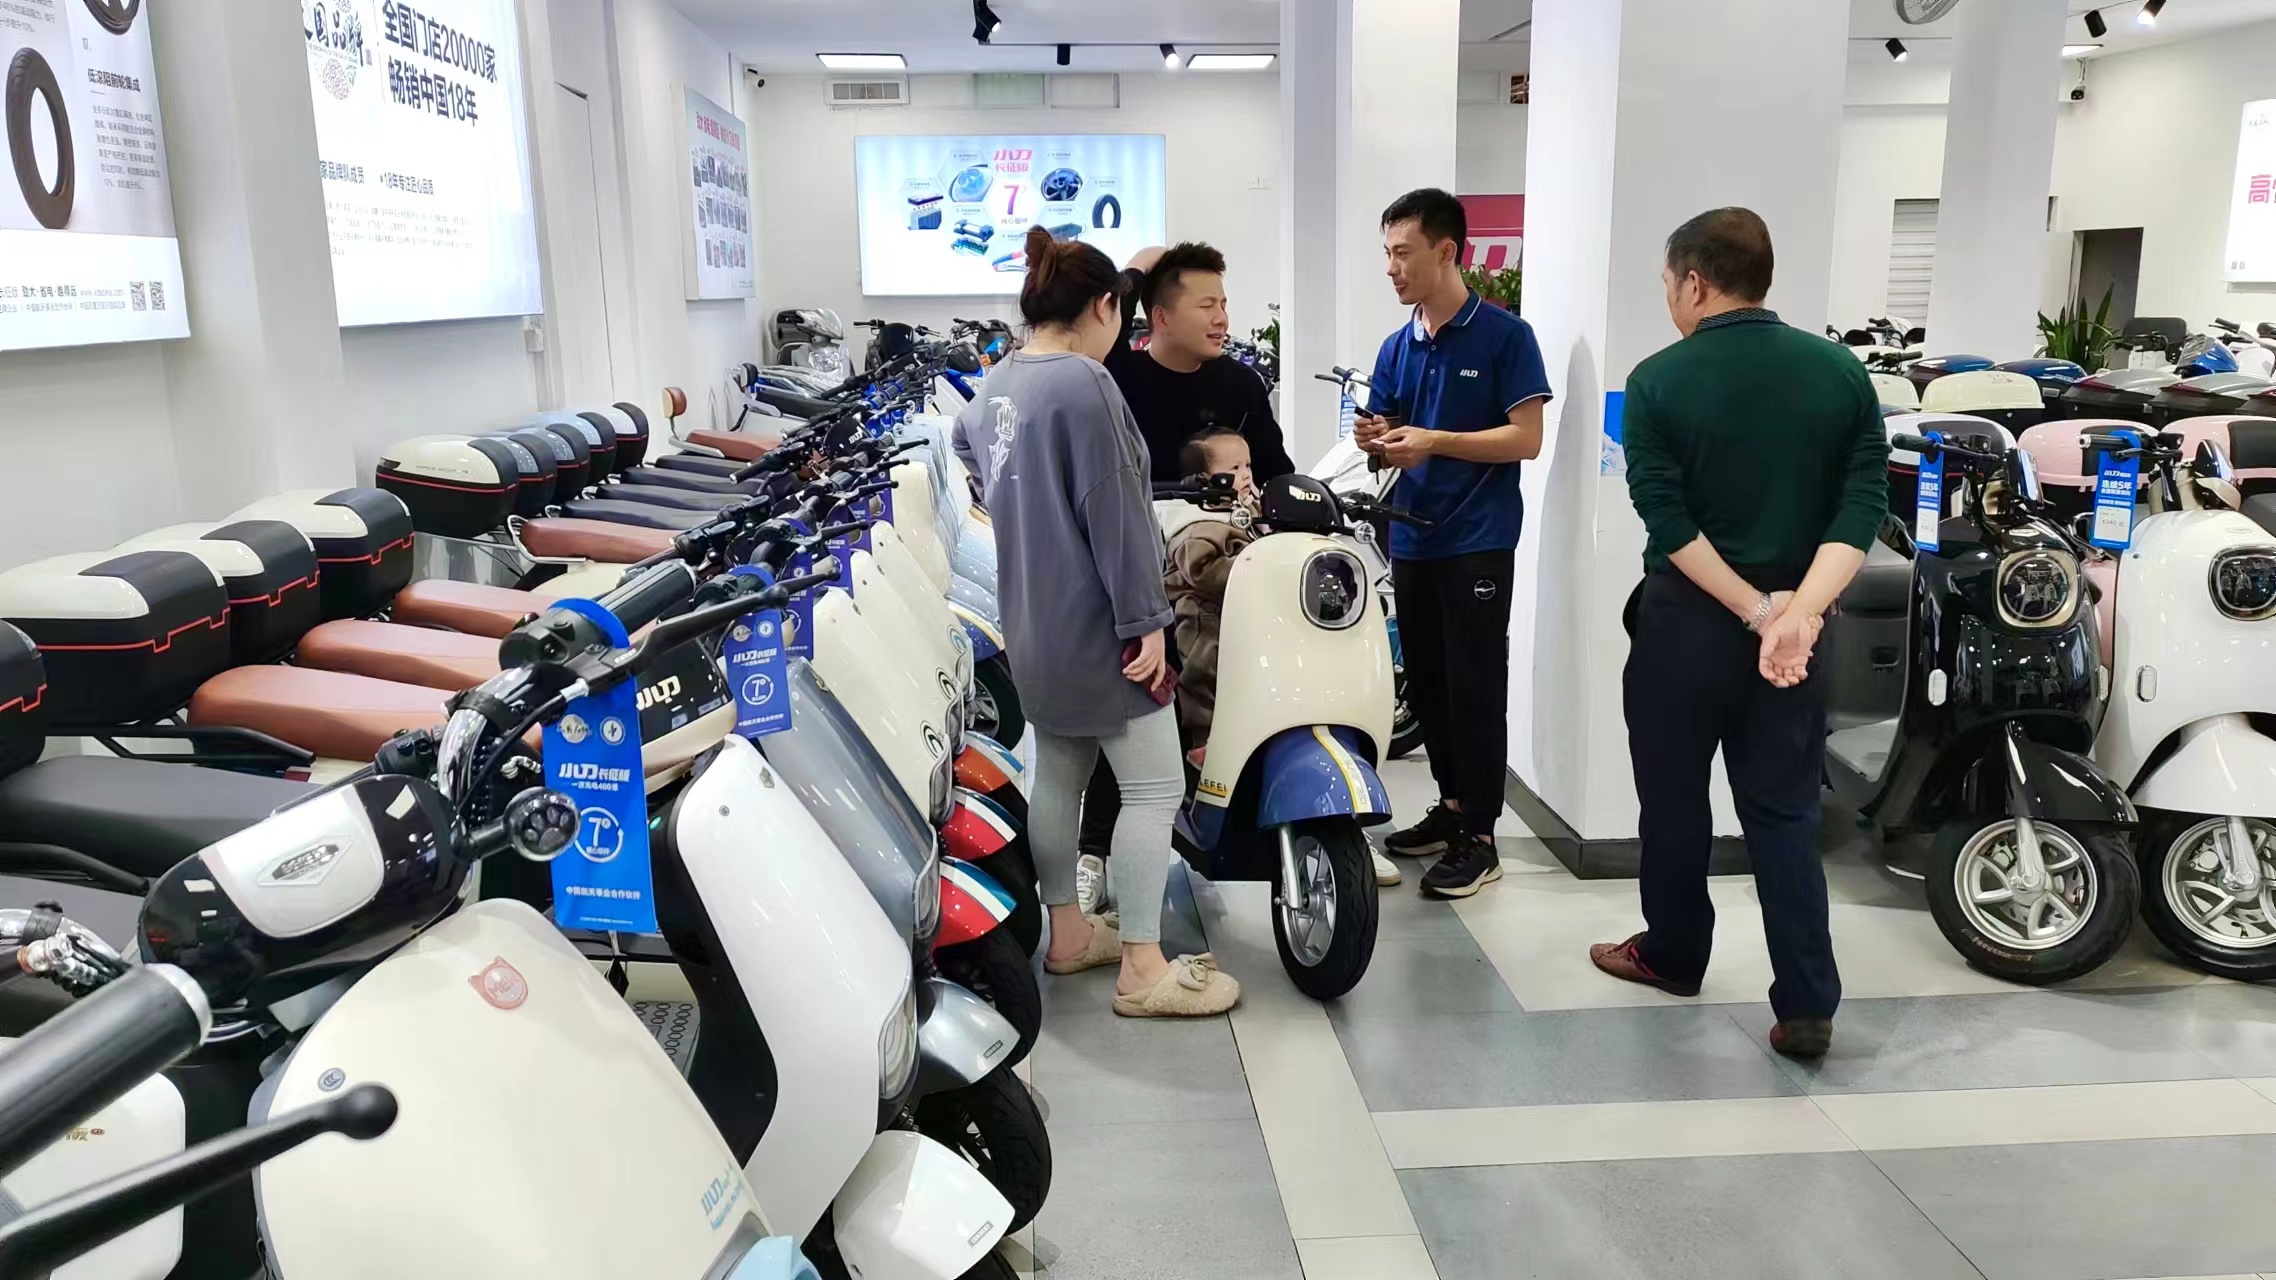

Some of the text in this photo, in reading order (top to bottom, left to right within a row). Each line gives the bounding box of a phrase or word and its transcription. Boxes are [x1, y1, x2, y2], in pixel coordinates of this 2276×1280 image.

[382, 0, 497, 83] 全国门店20000家
[87, 68, 141, 93] 低滚阻前轮集成
[388, 56, 479, 126] 畅销中国18年
